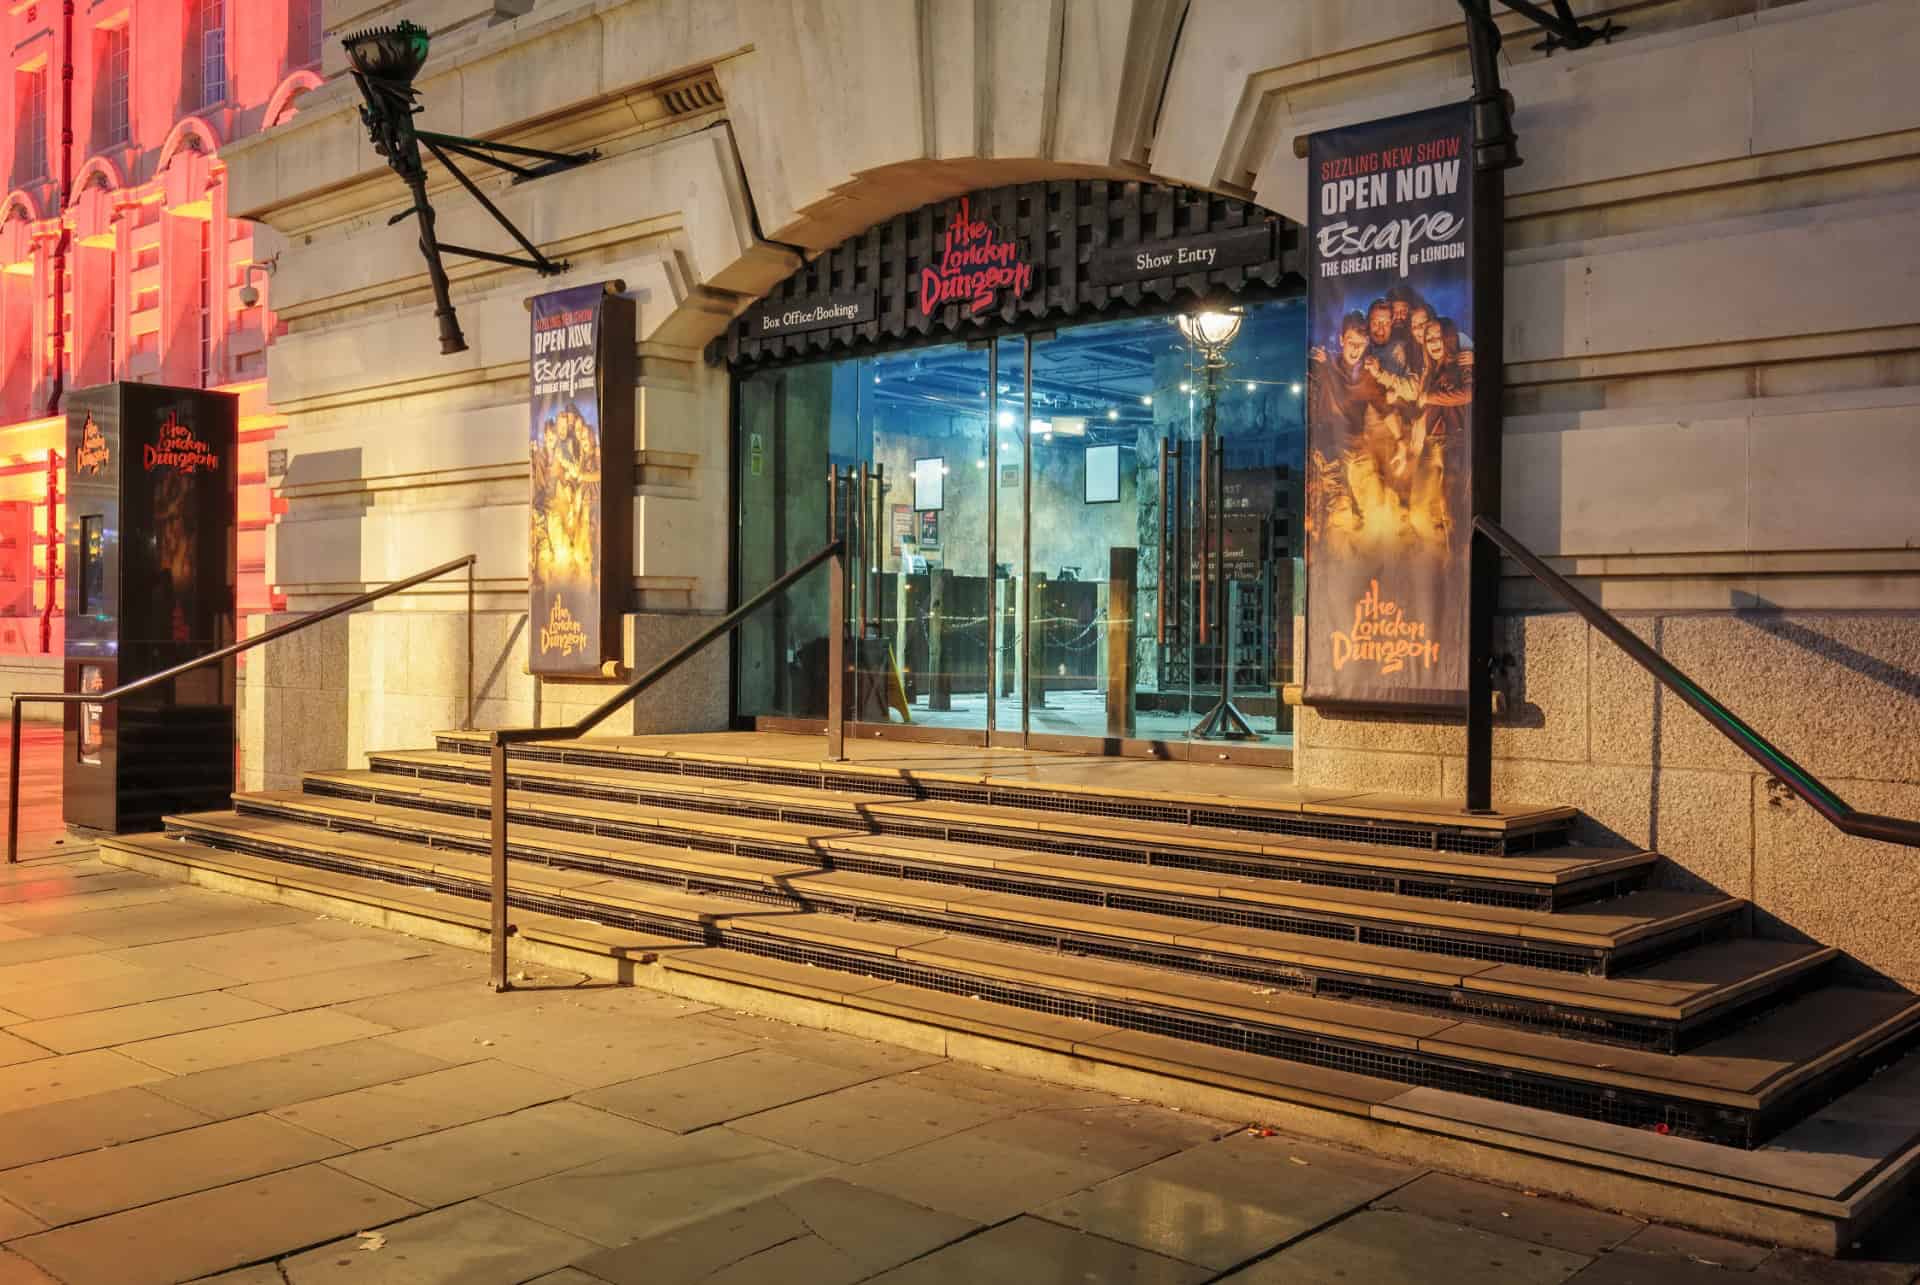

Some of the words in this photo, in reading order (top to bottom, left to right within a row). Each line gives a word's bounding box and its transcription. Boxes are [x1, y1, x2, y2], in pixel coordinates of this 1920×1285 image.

[1321, 153, 1379, 181] SIZZLING
[1382, 145, 1414, 170] NEW
[1417, 136, 1461, 164] SHOW
[1320, 173, 1388, 216] OPEN
[1396, 159, 1460, 203] NOW
[950, 197, 988, 246] the
[941, 230, 1016, 277] London
[1136, 253, 1173, 270] Show
[1178, 248, 1217, 265] Entry
[1316, 210, 1465, 279] Escape
[1320, 262, 1340, 278] THE
[1341, 255, 1374, 276] GREAT
[1375, 252, 1399, 270] FIRE
[1421, 242, 1465, 263] LONDON
[921, 267, 1032, 315] Dungeon
[535, 328, 566, 354] OPEN
[568, 322, 593, 348] NOW
[763, 316, 780, 329] Box
[783, 304, 858, 326] Office/Bookings
[534, 355, 594, 398] Escape
[144, 443, 218, 475] Dungeon
[1360, 577, 1396, 620] the
[541, 628, 587, 656] Dungeon
[1351, 602, 1424, 641] London
[1330, 631, 1440, 674] Dungeon
